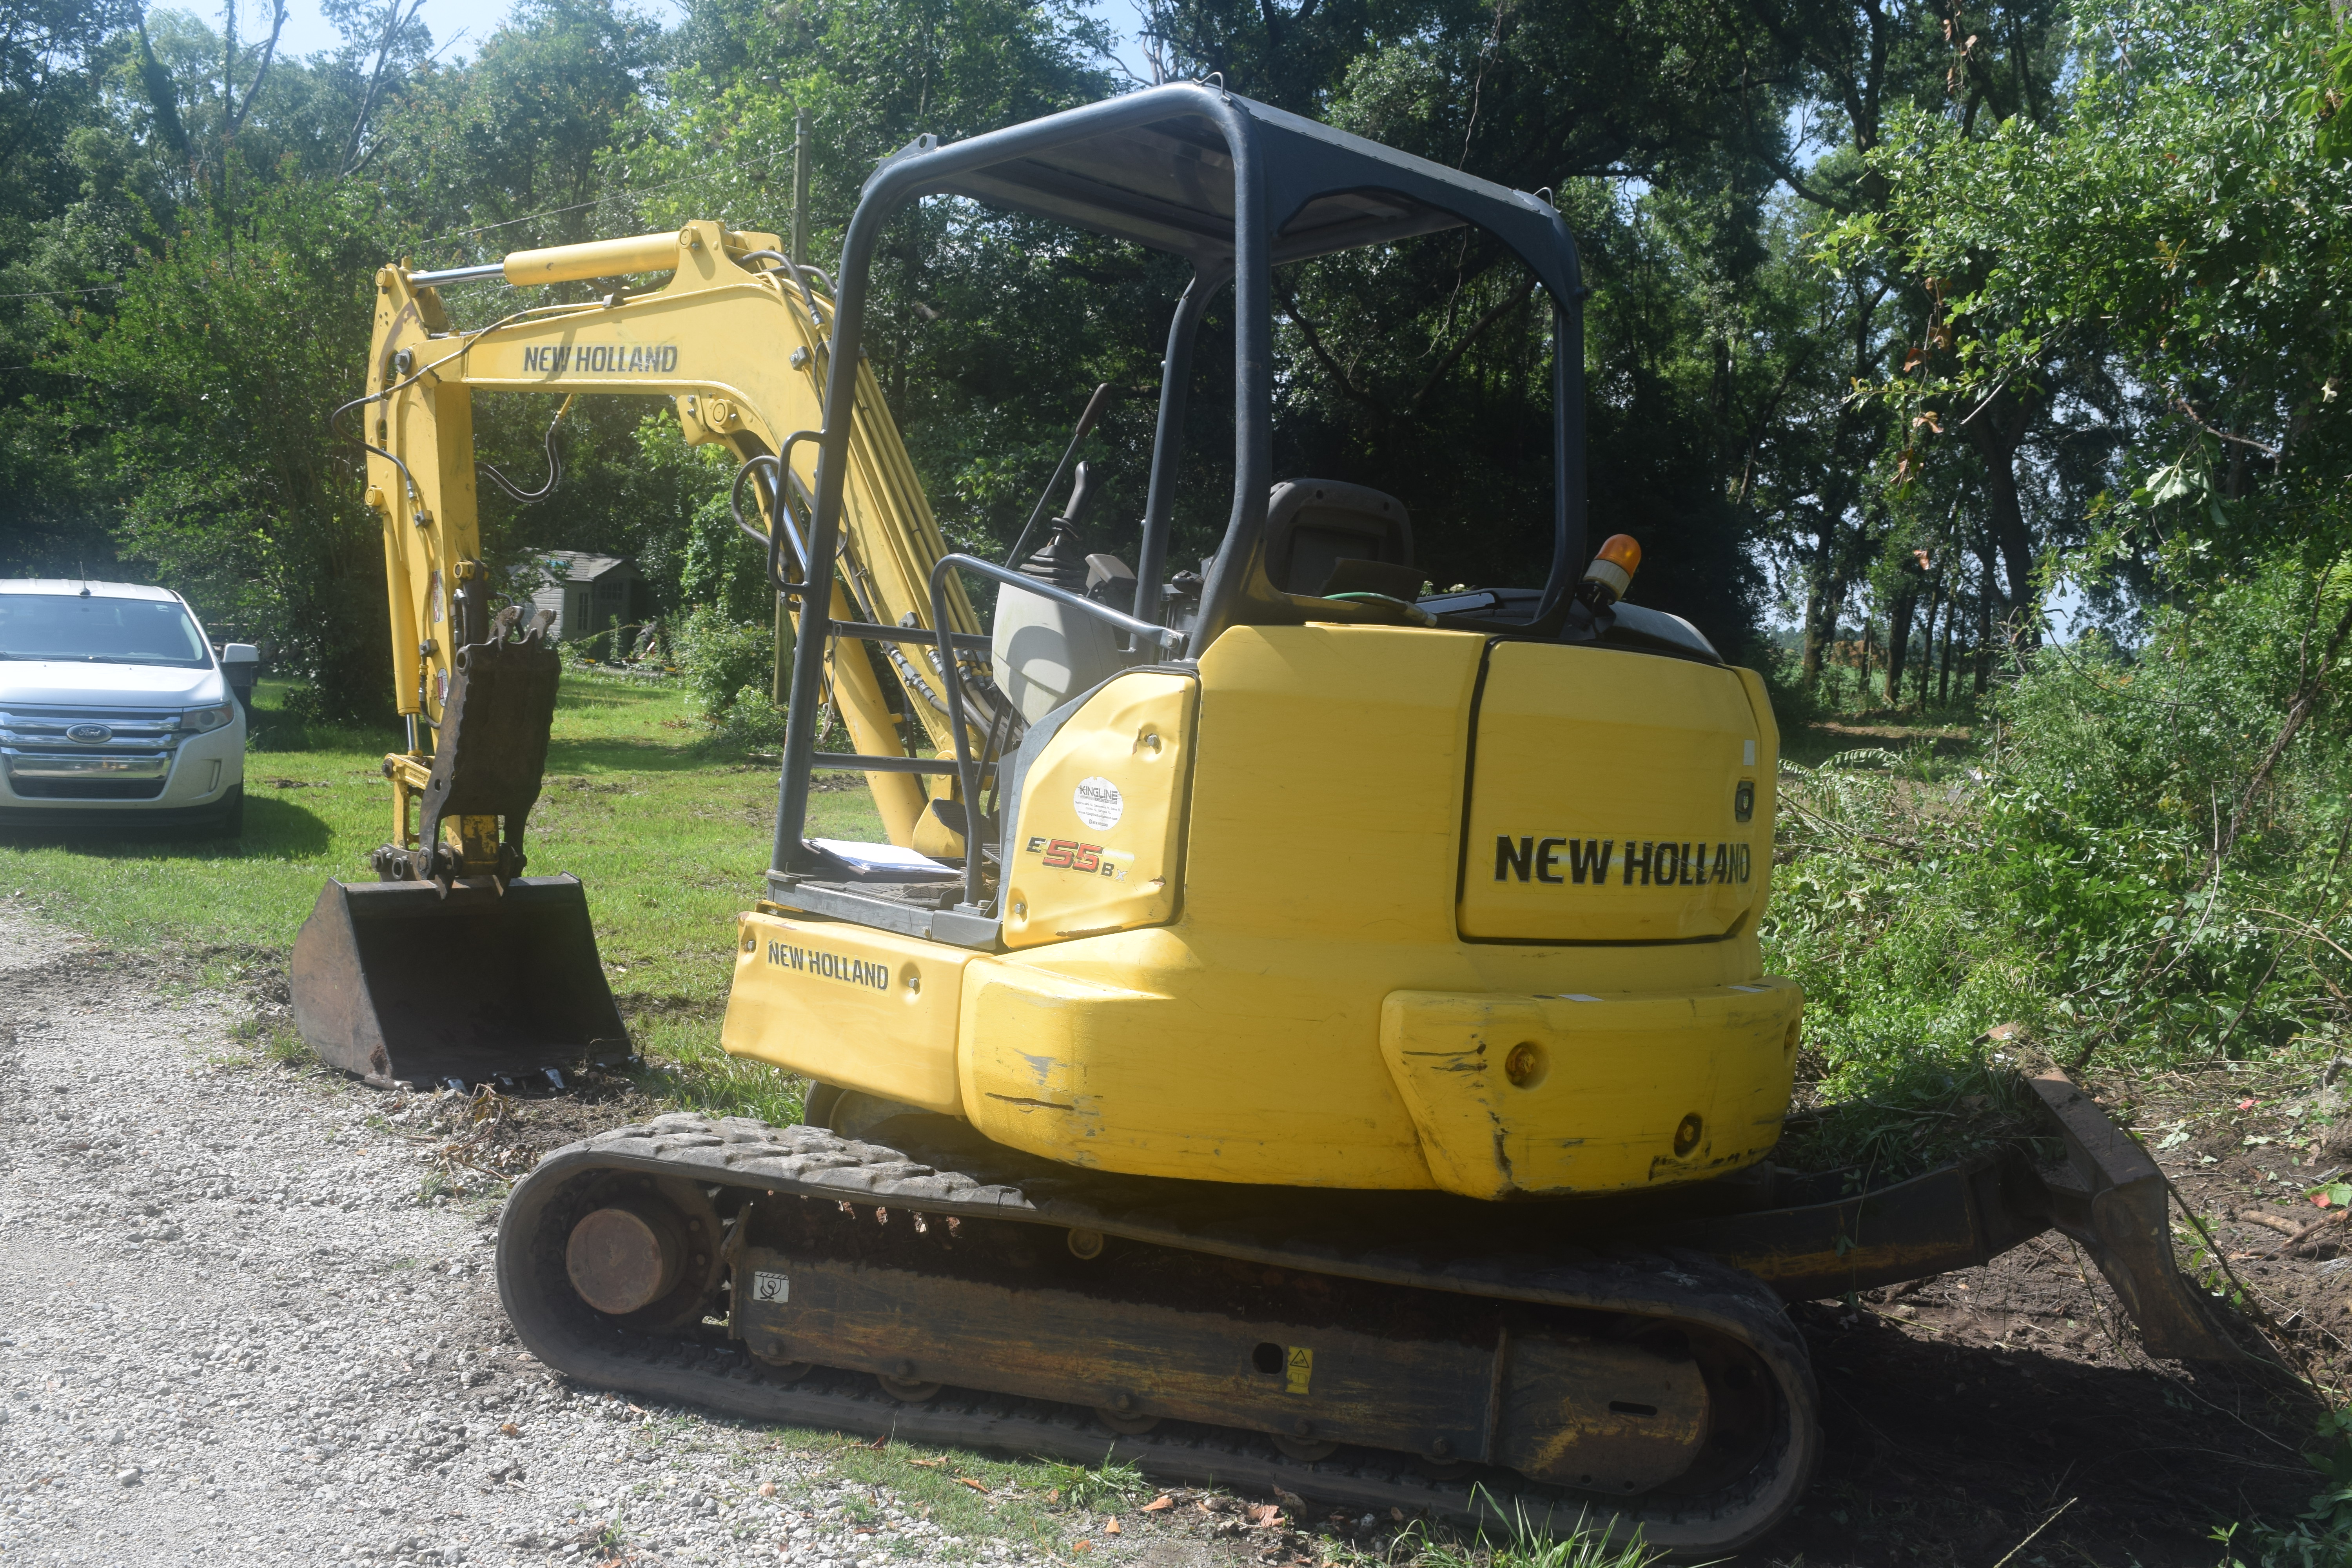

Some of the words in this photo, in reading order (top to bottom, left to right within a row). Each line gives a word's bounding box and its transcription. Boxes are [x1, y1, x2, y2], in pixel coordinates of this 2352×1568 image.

[524, 346, 571, 372] NEW
[575, 345, 678, 372] HOLLAND
[79, 728, 100, 736] Ford
[1080, 785, 1118, 800] KINGLINE
[1494, 835, 1614, 886] NEW
[1622, 840, 1751, 887] HOLLAND
[768, 940, 804, 971] NEW
[808, 949, 889, 991] HOLLAND
